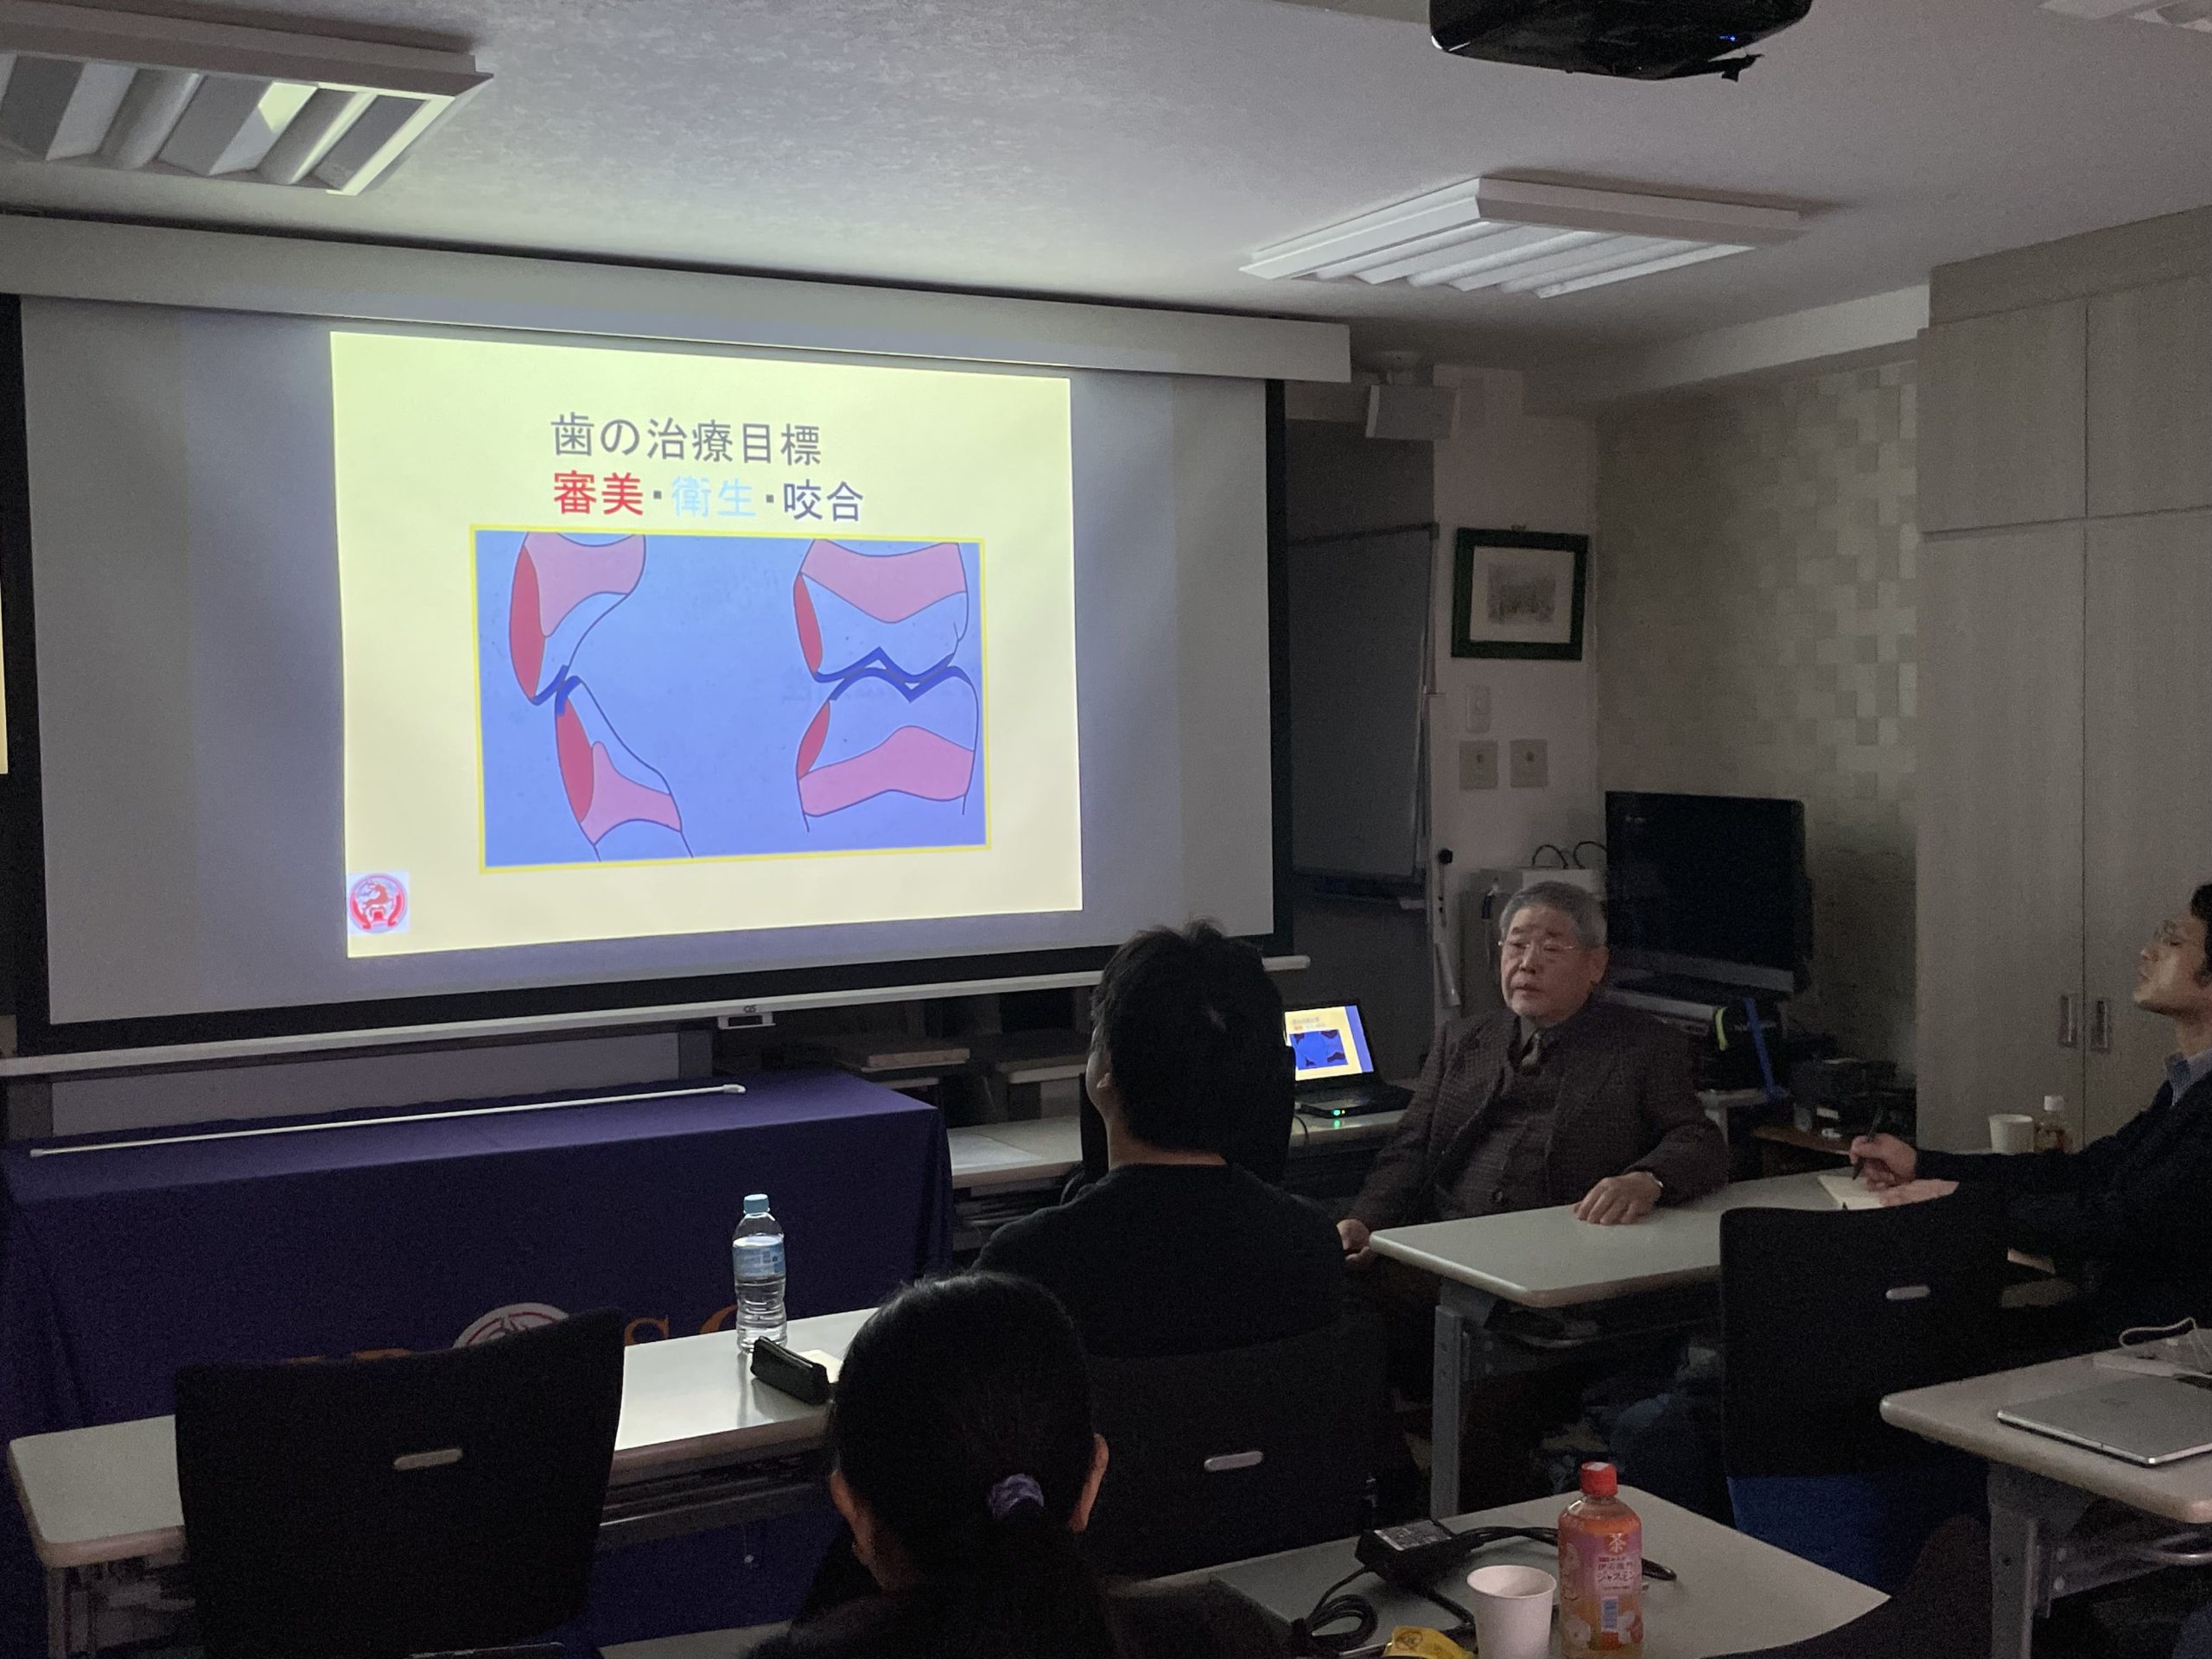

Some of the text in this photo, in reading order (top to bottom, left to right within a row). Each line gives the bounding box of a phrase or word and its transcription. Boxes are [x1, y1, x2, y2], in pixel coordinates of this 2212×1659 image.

[550, 411, 822, 466] 歯の治療目標
[1609, 1533, 1627, 1553] 茶
